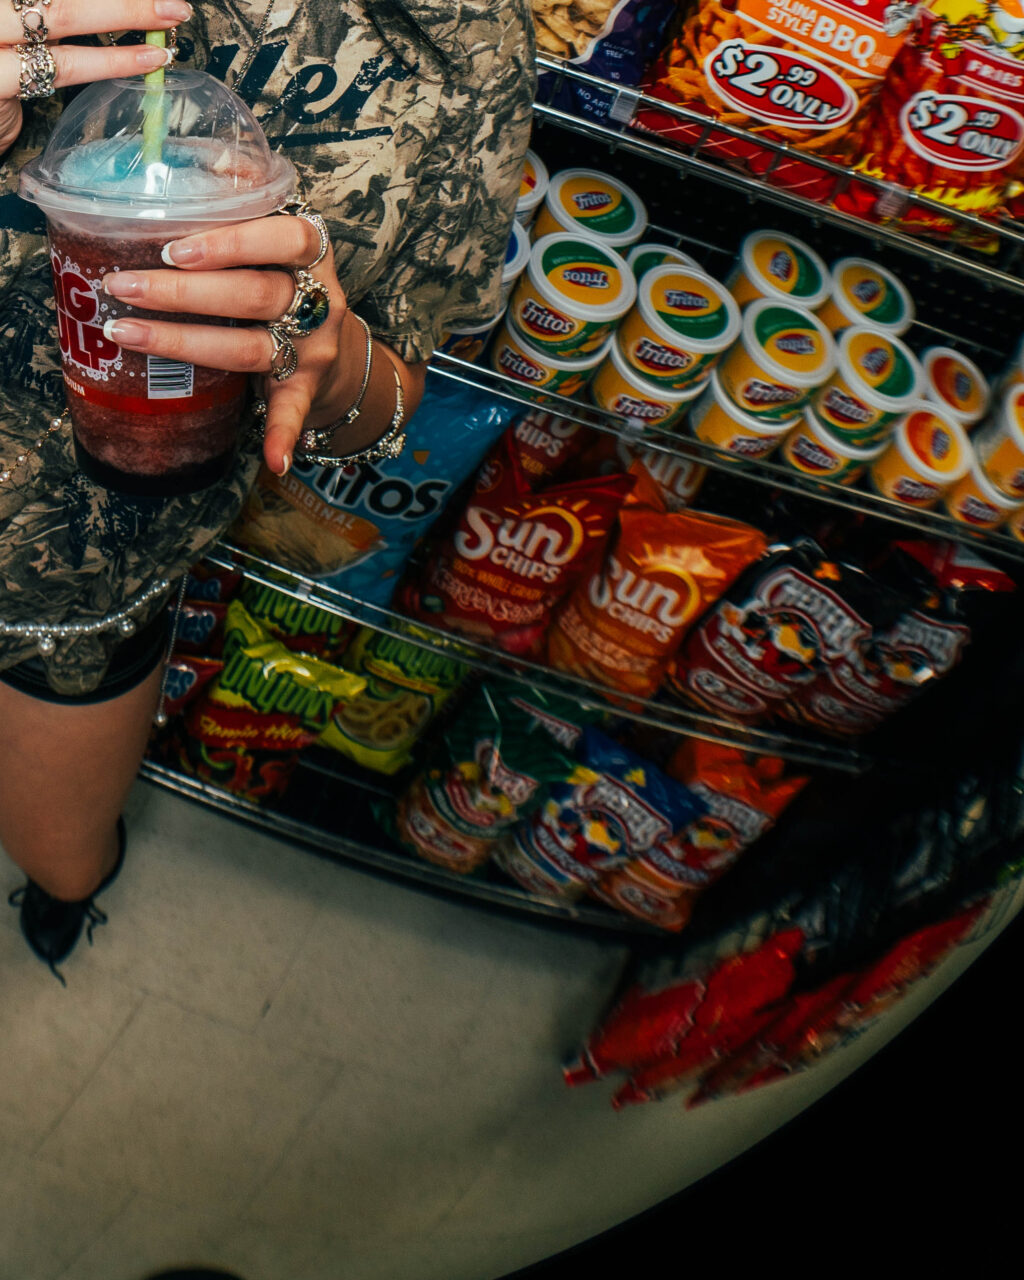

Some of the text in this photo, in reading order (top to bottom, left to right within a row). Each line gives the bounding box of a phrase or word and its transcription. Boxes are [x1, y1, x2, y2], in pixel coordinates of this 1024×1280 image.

[766, 6, 814, 37] STYLE
[810, 14, 877, 68] BBQ
[714, 44, 818, 99] $2.99
[966, 59, 1024, 89] FRIES
[770, 83, 841, 122] ONLY
[960, 127, 1020, 161] ONLY
[521, 297, 576, 338] Fritos
[499, 345, 548, 384] Fritos
[634, 336, 693, 371] Fritos
[514, 422, 566, 459] HIPS
[453, 506, 582, 567] Sun
[489, 548, 562, 584] CHIPS
[607, 601, 674, 645] CHIPS
